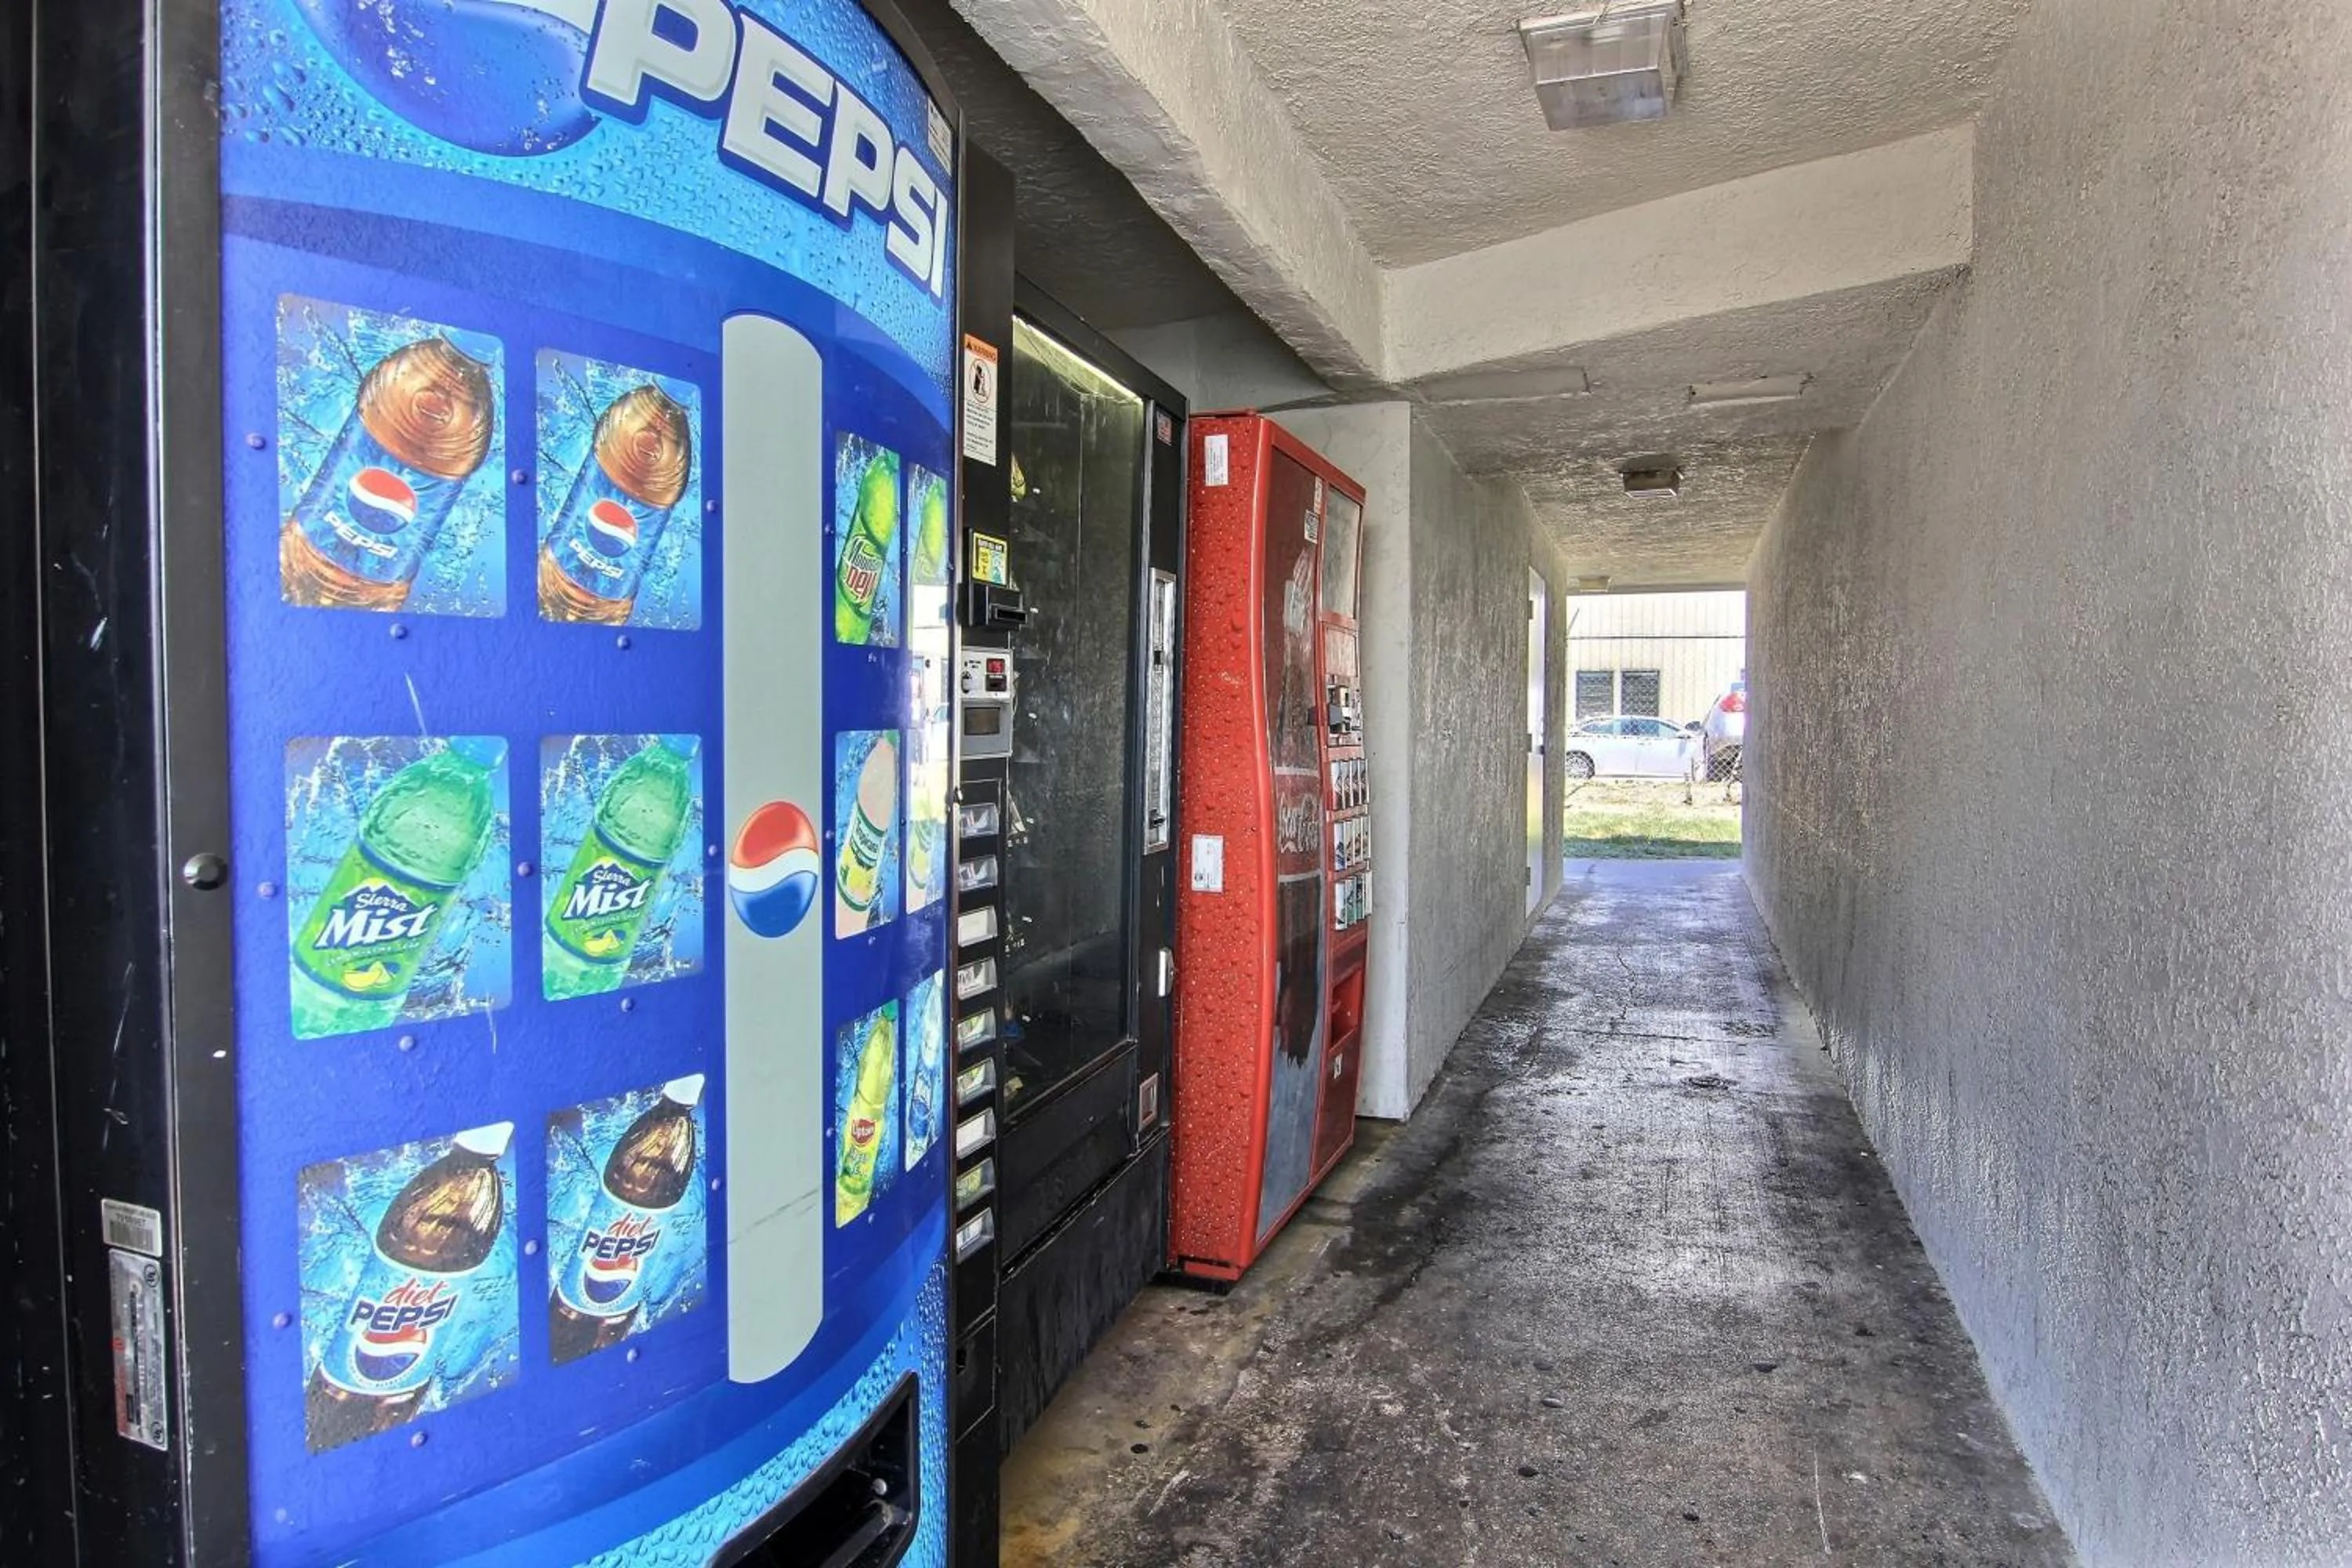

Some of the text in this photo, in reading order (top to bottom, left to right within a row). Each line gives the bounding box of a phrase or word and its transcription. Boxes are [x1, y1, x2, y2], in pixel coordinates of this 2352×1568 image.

[588, 0, 948, 298] PEPSI
[324, 510, 398, 558] PEPSI
[569, 538, 625, 579] PEPSI
[592, 869, 631, 885] Sierra
[355, 893, 408, 912] Sierra
[562, 878, 652, 919] Mist
[315, 902, 437, 948] Mist
[608, 1212, 654, 1236] diet
[581, 1229, 661, 1259] PEPSI
[384, 1277, 448, 1307] diet
[350, 1294, 458, 1330] PEPSI
